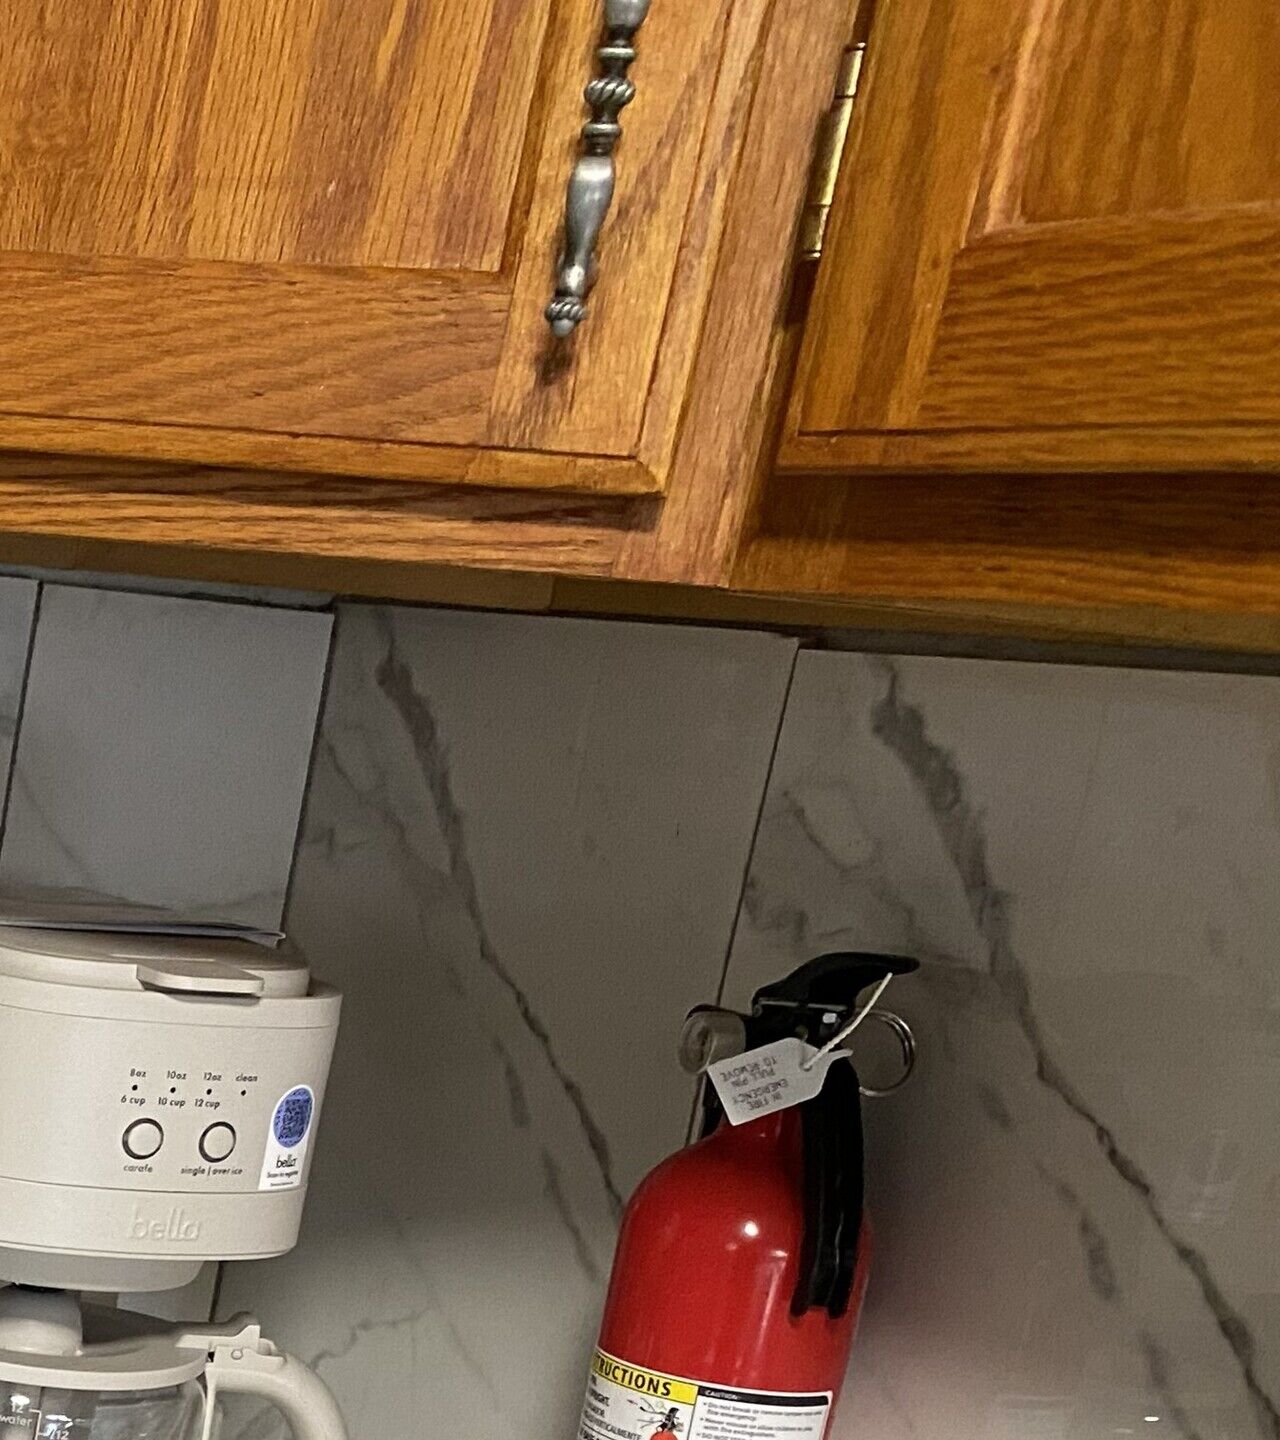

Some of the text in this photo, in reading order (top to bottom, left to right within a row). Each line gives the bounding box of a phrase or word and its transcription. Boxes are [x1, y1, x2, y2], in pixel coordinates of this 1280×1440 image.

[235, 1074, 258, 1082] clean
[120, 1095, 146, 1107] 6 cup
[158, 1097, 186, 1109] 10 cup
[194, 1098, 220, 1110] 12 cup
[275, 1154, 298, 1168] bella
[123, 1164, 153, 1173] carafe
[132, 1204, 201, 1242] bella
[0, 1414, 33, 1427] water
